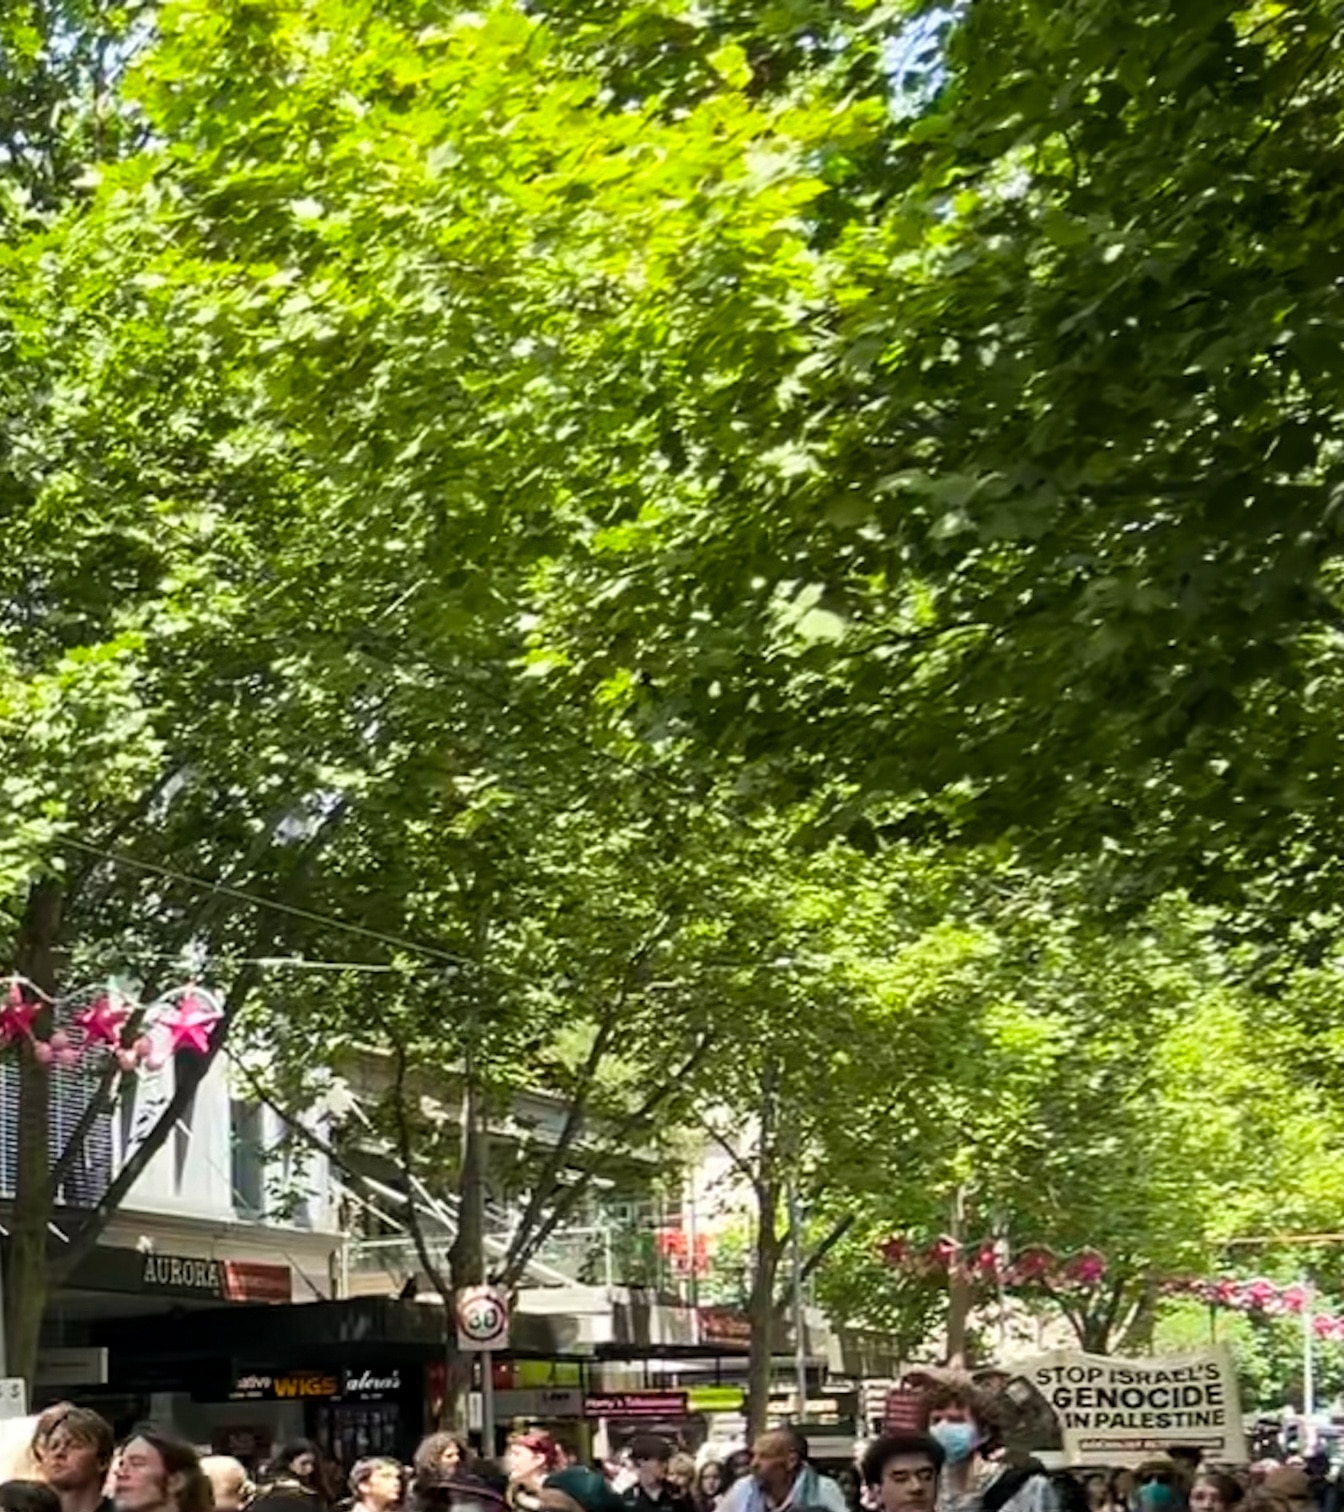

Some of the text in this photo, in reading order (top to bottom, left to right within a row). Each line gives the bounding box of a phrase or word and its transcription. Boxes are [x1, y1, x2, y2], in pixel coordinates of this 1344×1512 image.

[143, 1257, 220, 1287] AURORA
[469, 1308, 498, 1330] 30
[1037, 1363, 1220, 1386] STOP ISRAEL'S
[274, 1377, 338, 1397] WIGS
[1052, 1384, 1224, 1410] GENOCIDE
[1066, 1409, 1225, 1430] IN PALESTINE
